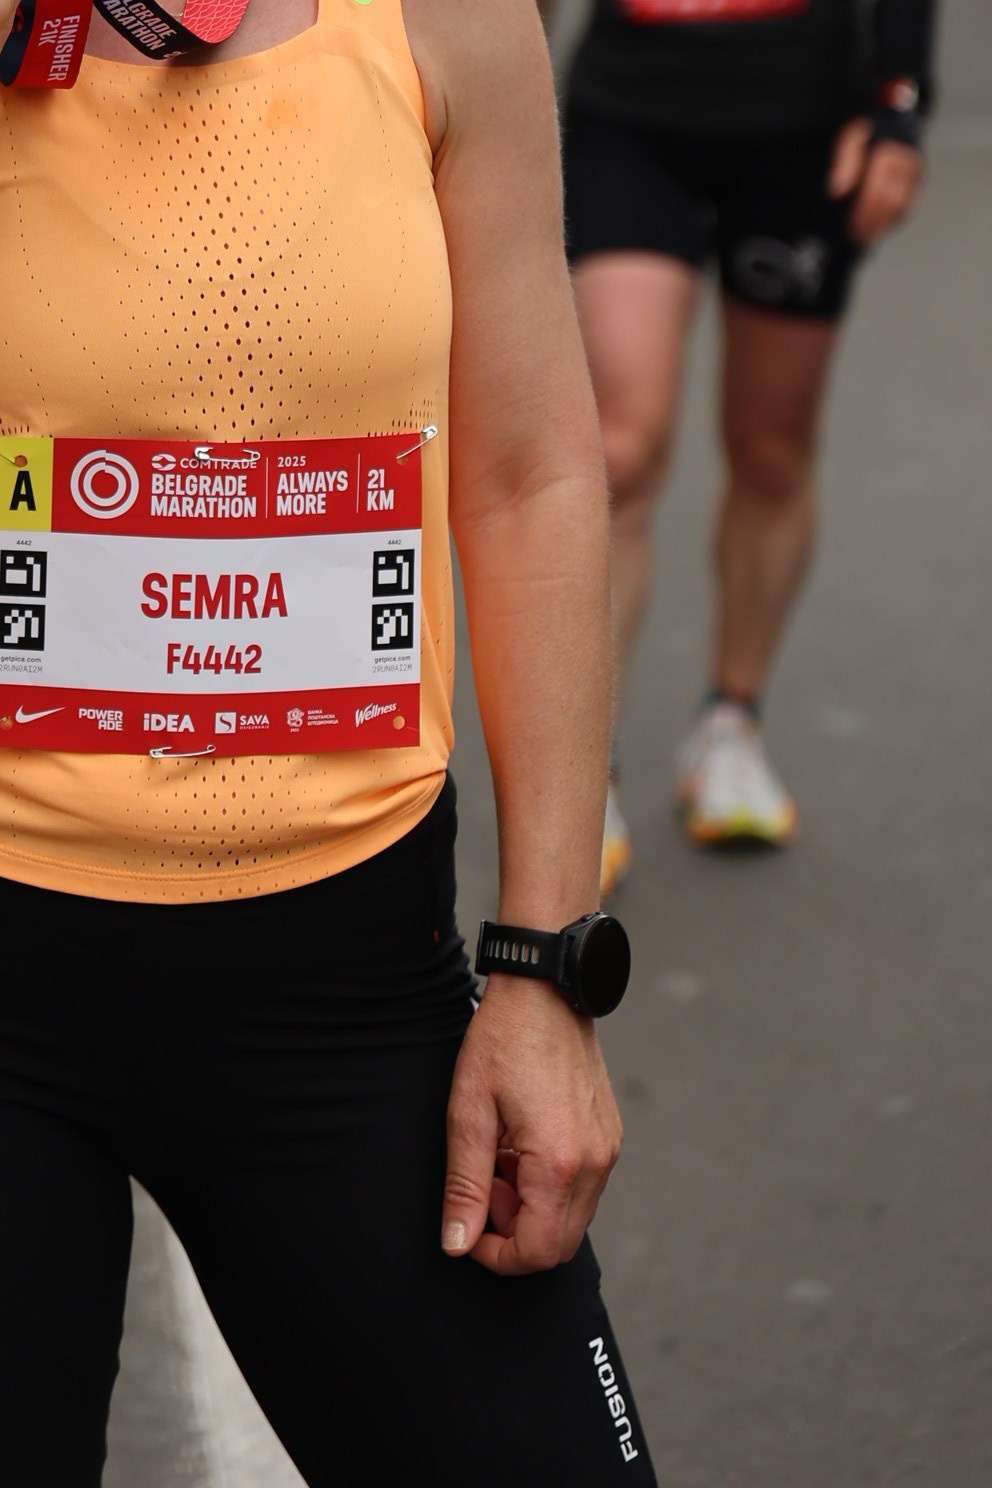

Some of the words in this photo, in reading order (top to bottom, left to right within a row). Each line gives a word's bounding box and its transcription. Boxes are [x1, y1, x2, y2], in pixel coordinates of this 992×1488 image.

[38, 18, 61, 47] 21K
[47, 14, 80, 82] FINISHER
[179, 457, 257, 470] COMTRADE
[277, 456, 306, 468] 2025
[9, 470, 37, 511] A
[151, 473, 248, 496] BELGRADE
[276, 470, 349, 495] ALWAYS
[367, 468, 385, 490] 21
[150, 495, 257, 519] MARATHON
[276, 493, 327, 517] MORE
[367, 489, 395, 512] KM
[16, 539, 33, 547] 4442
[140, 572, 288, 619] SEMRA
[0, 655, 42, 664] getpica.com
[166, 643, 263, 675] F4442
[374, 655, 411, 665] getpica.com
[78, 708, 123, 721] POWER
[98, 720, 124, 731] ADE
[143, 713, 195, 733] iDEA
[239, 715, 270, 726] SAVA
[355, 702, 397, 728] Wellness
[588, 1336, 639, 1463] FUSION
